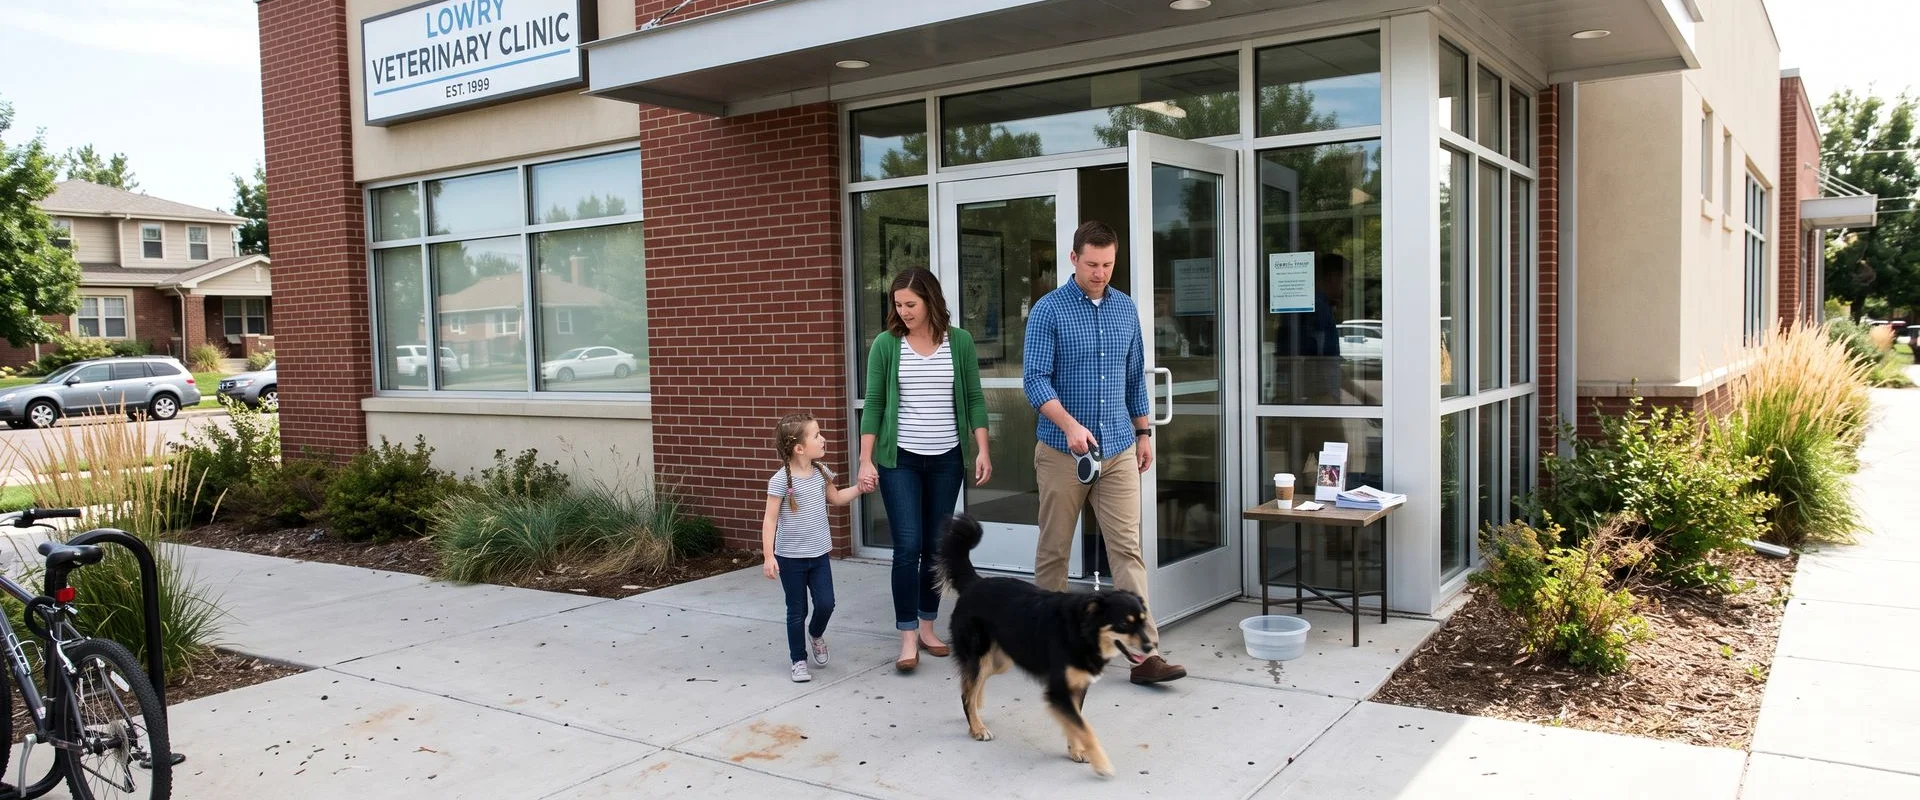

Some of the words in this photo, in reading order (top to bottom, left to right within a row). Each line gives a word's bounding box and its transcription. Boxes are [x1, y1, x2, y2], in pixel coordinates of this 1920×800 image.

[426, 0, 504, 38] LOWRY
[372, 31, 492, 85] VETERINARY
[499, 12, 570, 55] CLINIC
[445, 84, 465, 98] EST.
[467, 78, 490, 93] 1999
